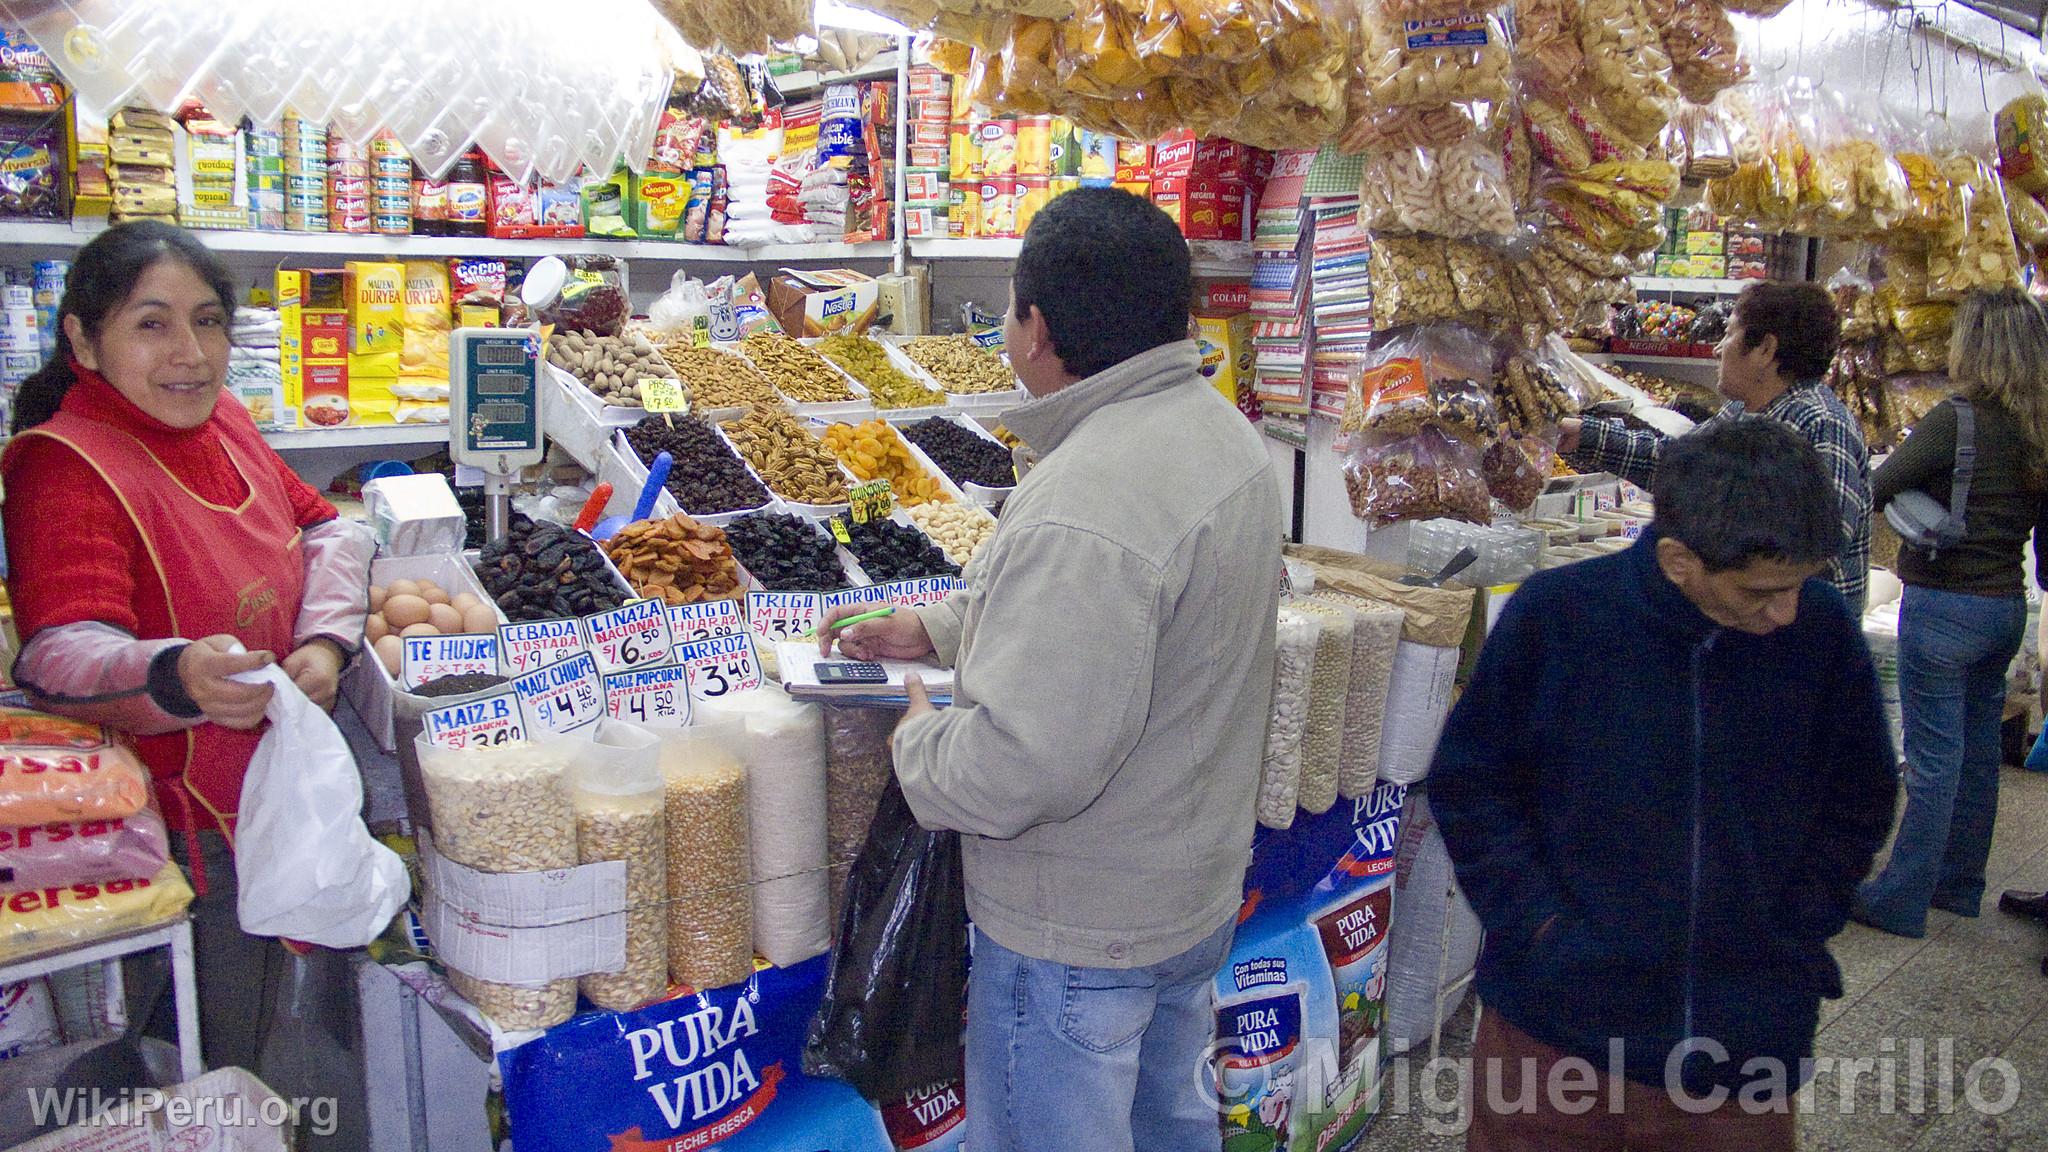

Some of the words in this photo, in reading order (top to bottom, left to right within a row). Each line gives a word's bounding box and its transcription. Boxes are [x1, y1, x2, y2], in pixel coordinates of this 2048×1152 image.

[1158, 142, 1190, 165] Royal
[1190, 191, 1216, 199] NEGRITA
[456, 261, 505, 278] COCOA
[361, 289, 401, 304] DURYEA
[404, 289, 445, 305] URYEA
[1212, 292, 1248, 303] COLAPI
[825, 585, 886, 609] MORON
[888, 575, 952, 597] MORON
[668, 601, 731, 622] TRIGO
[752, 593, 814, 608] TRIGO
[591, 601, 661, 633] LINAZA
[673, 615, 737, 632] HUARAZ
[756, 607, 814, 619] MOTE
[505, 621, 577, 643] CEBADA
[594, 615, 664, 644] NACIONAL
[641, 628, 660, 645] 50
[408, 639, 432, 662] TE
[512, 635, 580, 653] TOSTADA
[681, 634, 748, 663] ARROZ
[423, 663, 487, 674] EXTRA
[515, 671, 551, 700] MAIZ
[551, 654, 596, 687] CHULPE
[606, 674, 634, 692] MAIZ
[635, 666, 684, 688] POPCORN
[727, 658, 751, 679] 40
[609, 681, 675, 698] AMERICANA
[654, 689, 674, 706] 50
[555, 692, 576, 718] 4
[576, 684, 593, 702] 40
[1355, 816, 1400, 856] VID
[1367, 859, 1395, 874] LECHE
[1335, 903, 1377, 938] PURA
[1344, 923, 1378, 951] VIDA
[1234, 963, 1249, 976] Con
[1250, 958, 1271, 970] todas
[1272, 959, 1286, 969] sus
[1235, 968, 1287, 990] Vitaminas
[1236, 1007, 1280, 1035] PURA
[625, 996, 760, 1081] PURA
[1240, 1028, 1281, 1054] VIDA
[647, 1047, 761, 1130] VIDA
[913, 1088, 961, 1127] VIDA
[667, 1131, 709, 1152] LECHE
[711, 1105, 755, 1140] FRESCA
